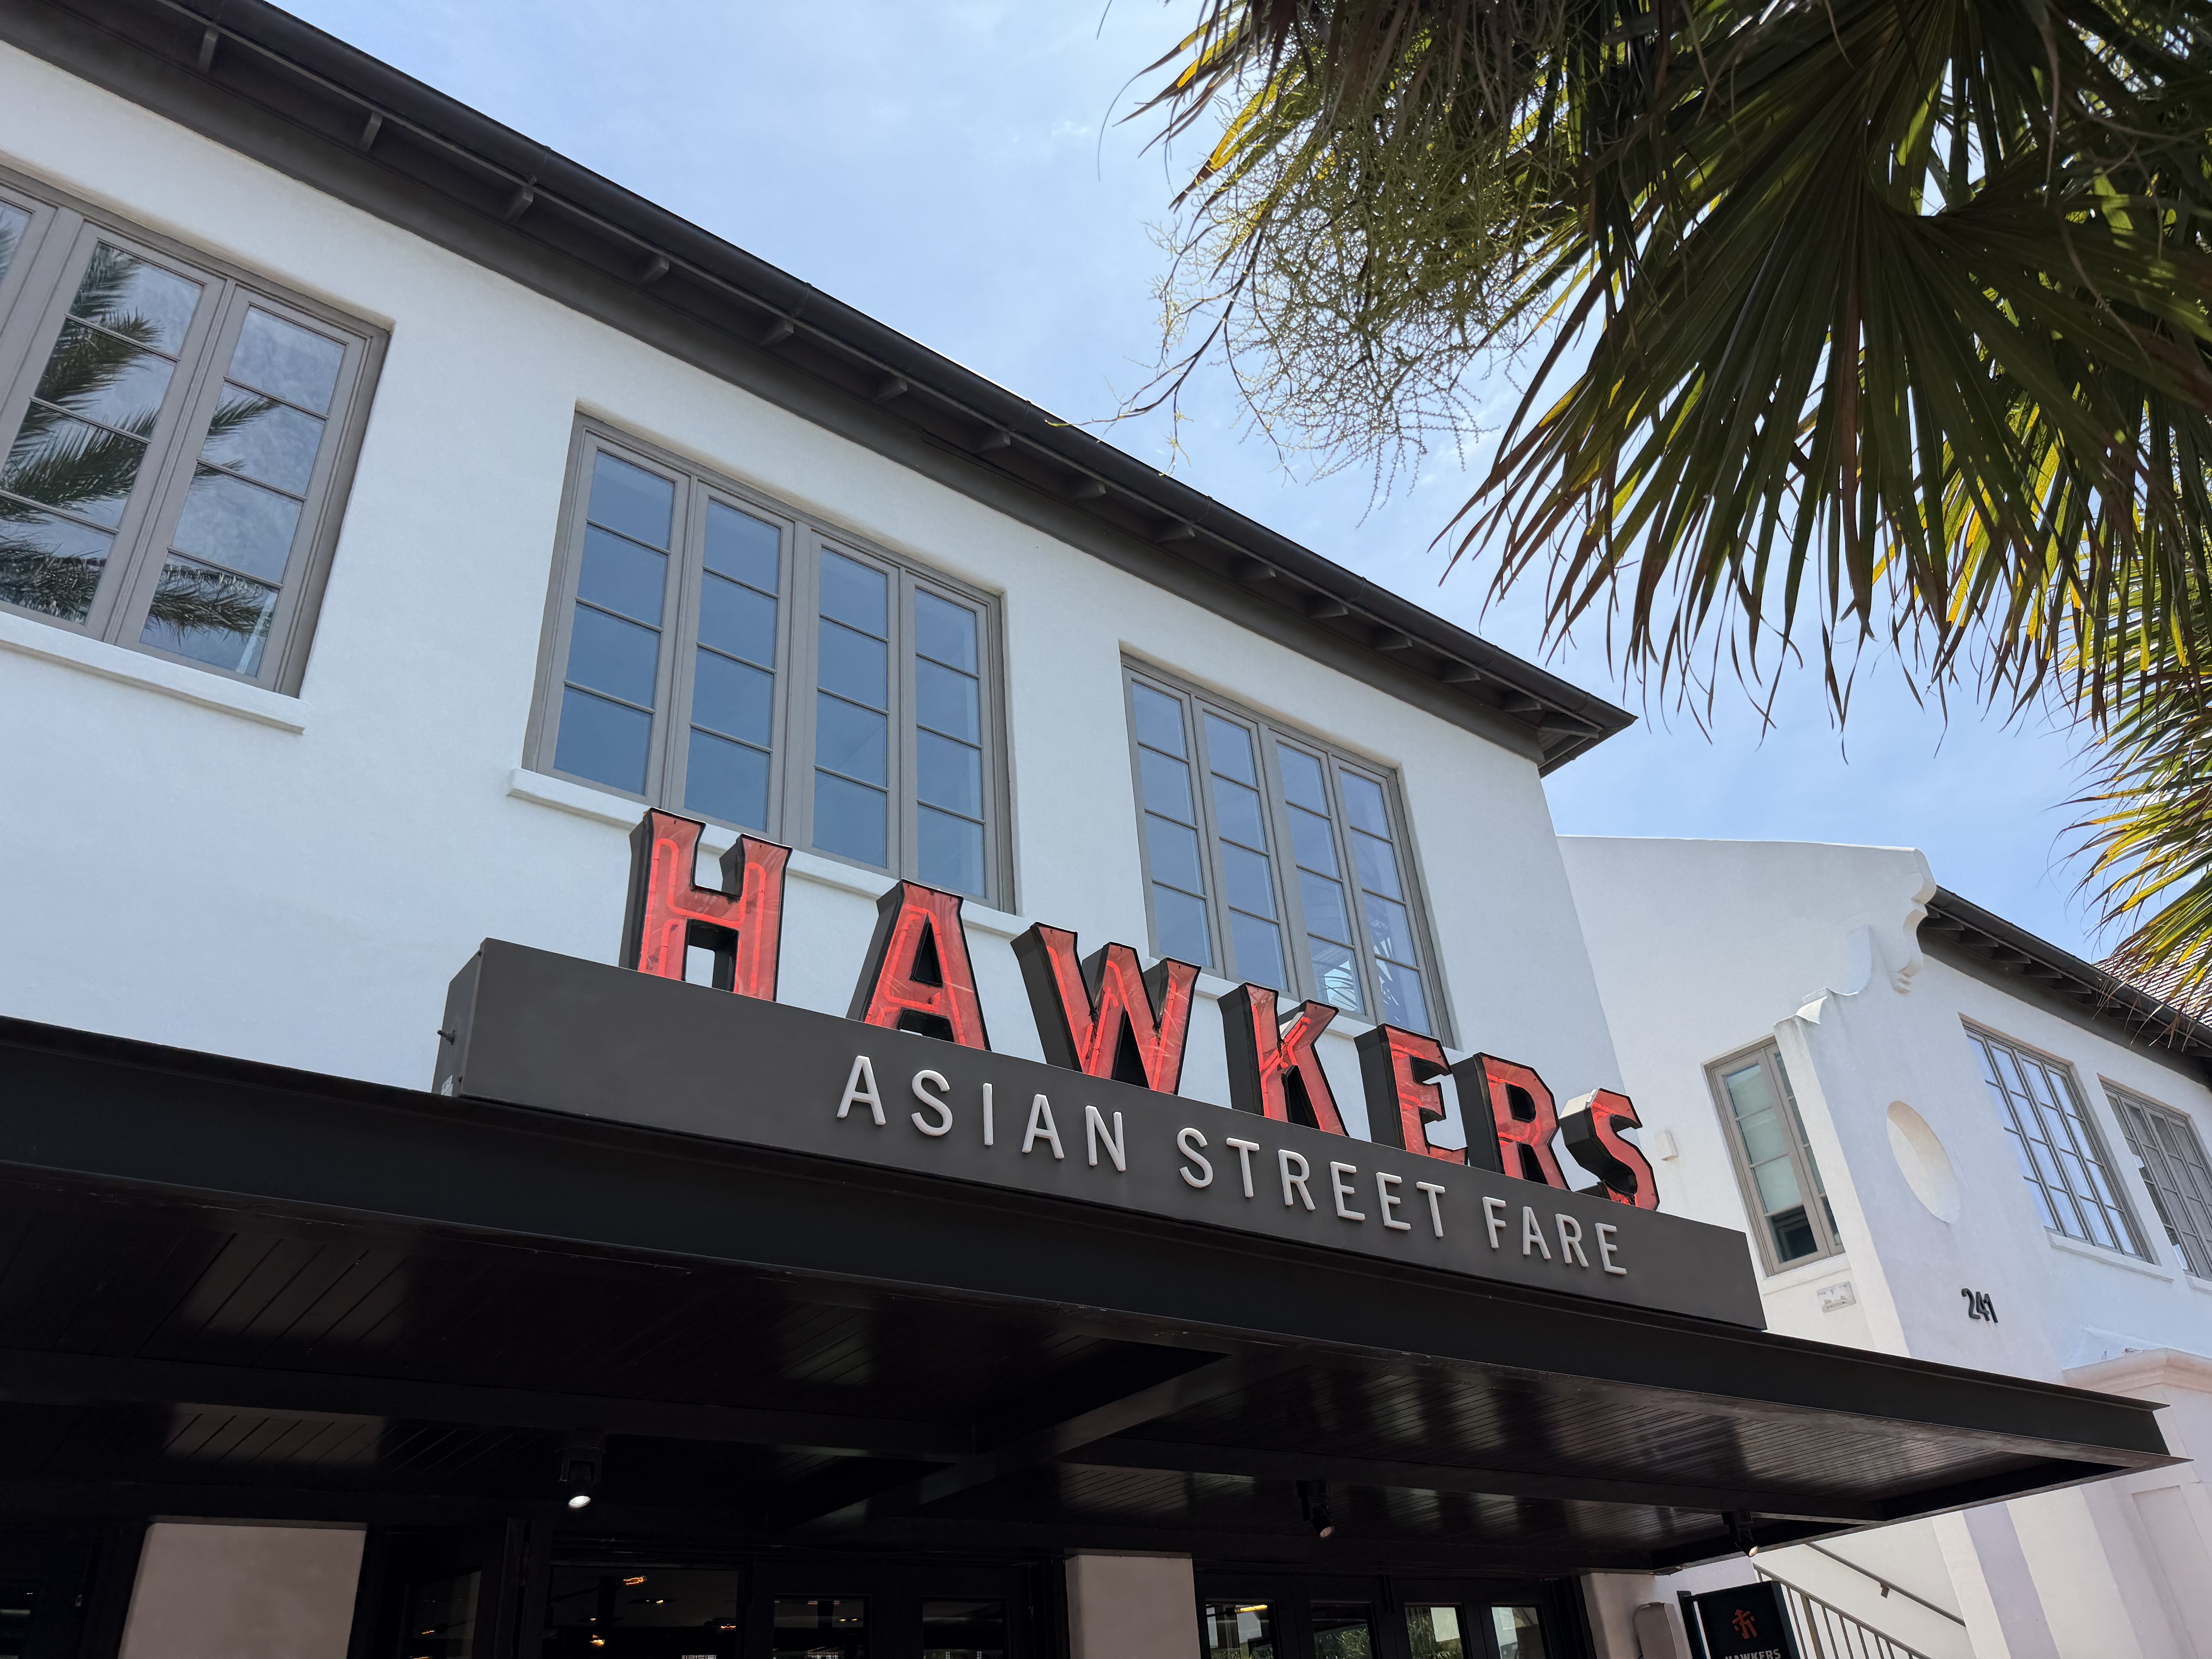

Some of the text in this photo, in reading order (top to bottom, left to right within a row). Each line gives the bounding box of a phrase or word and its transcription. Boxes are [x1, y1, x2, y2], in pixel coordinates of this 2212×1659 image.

[627, 808, 1660, 1211] HAWKERS
[837, 1055, 1627, 1274] ASIAN STREET FARE
[1961, 1288, 1999, 1323] 241
